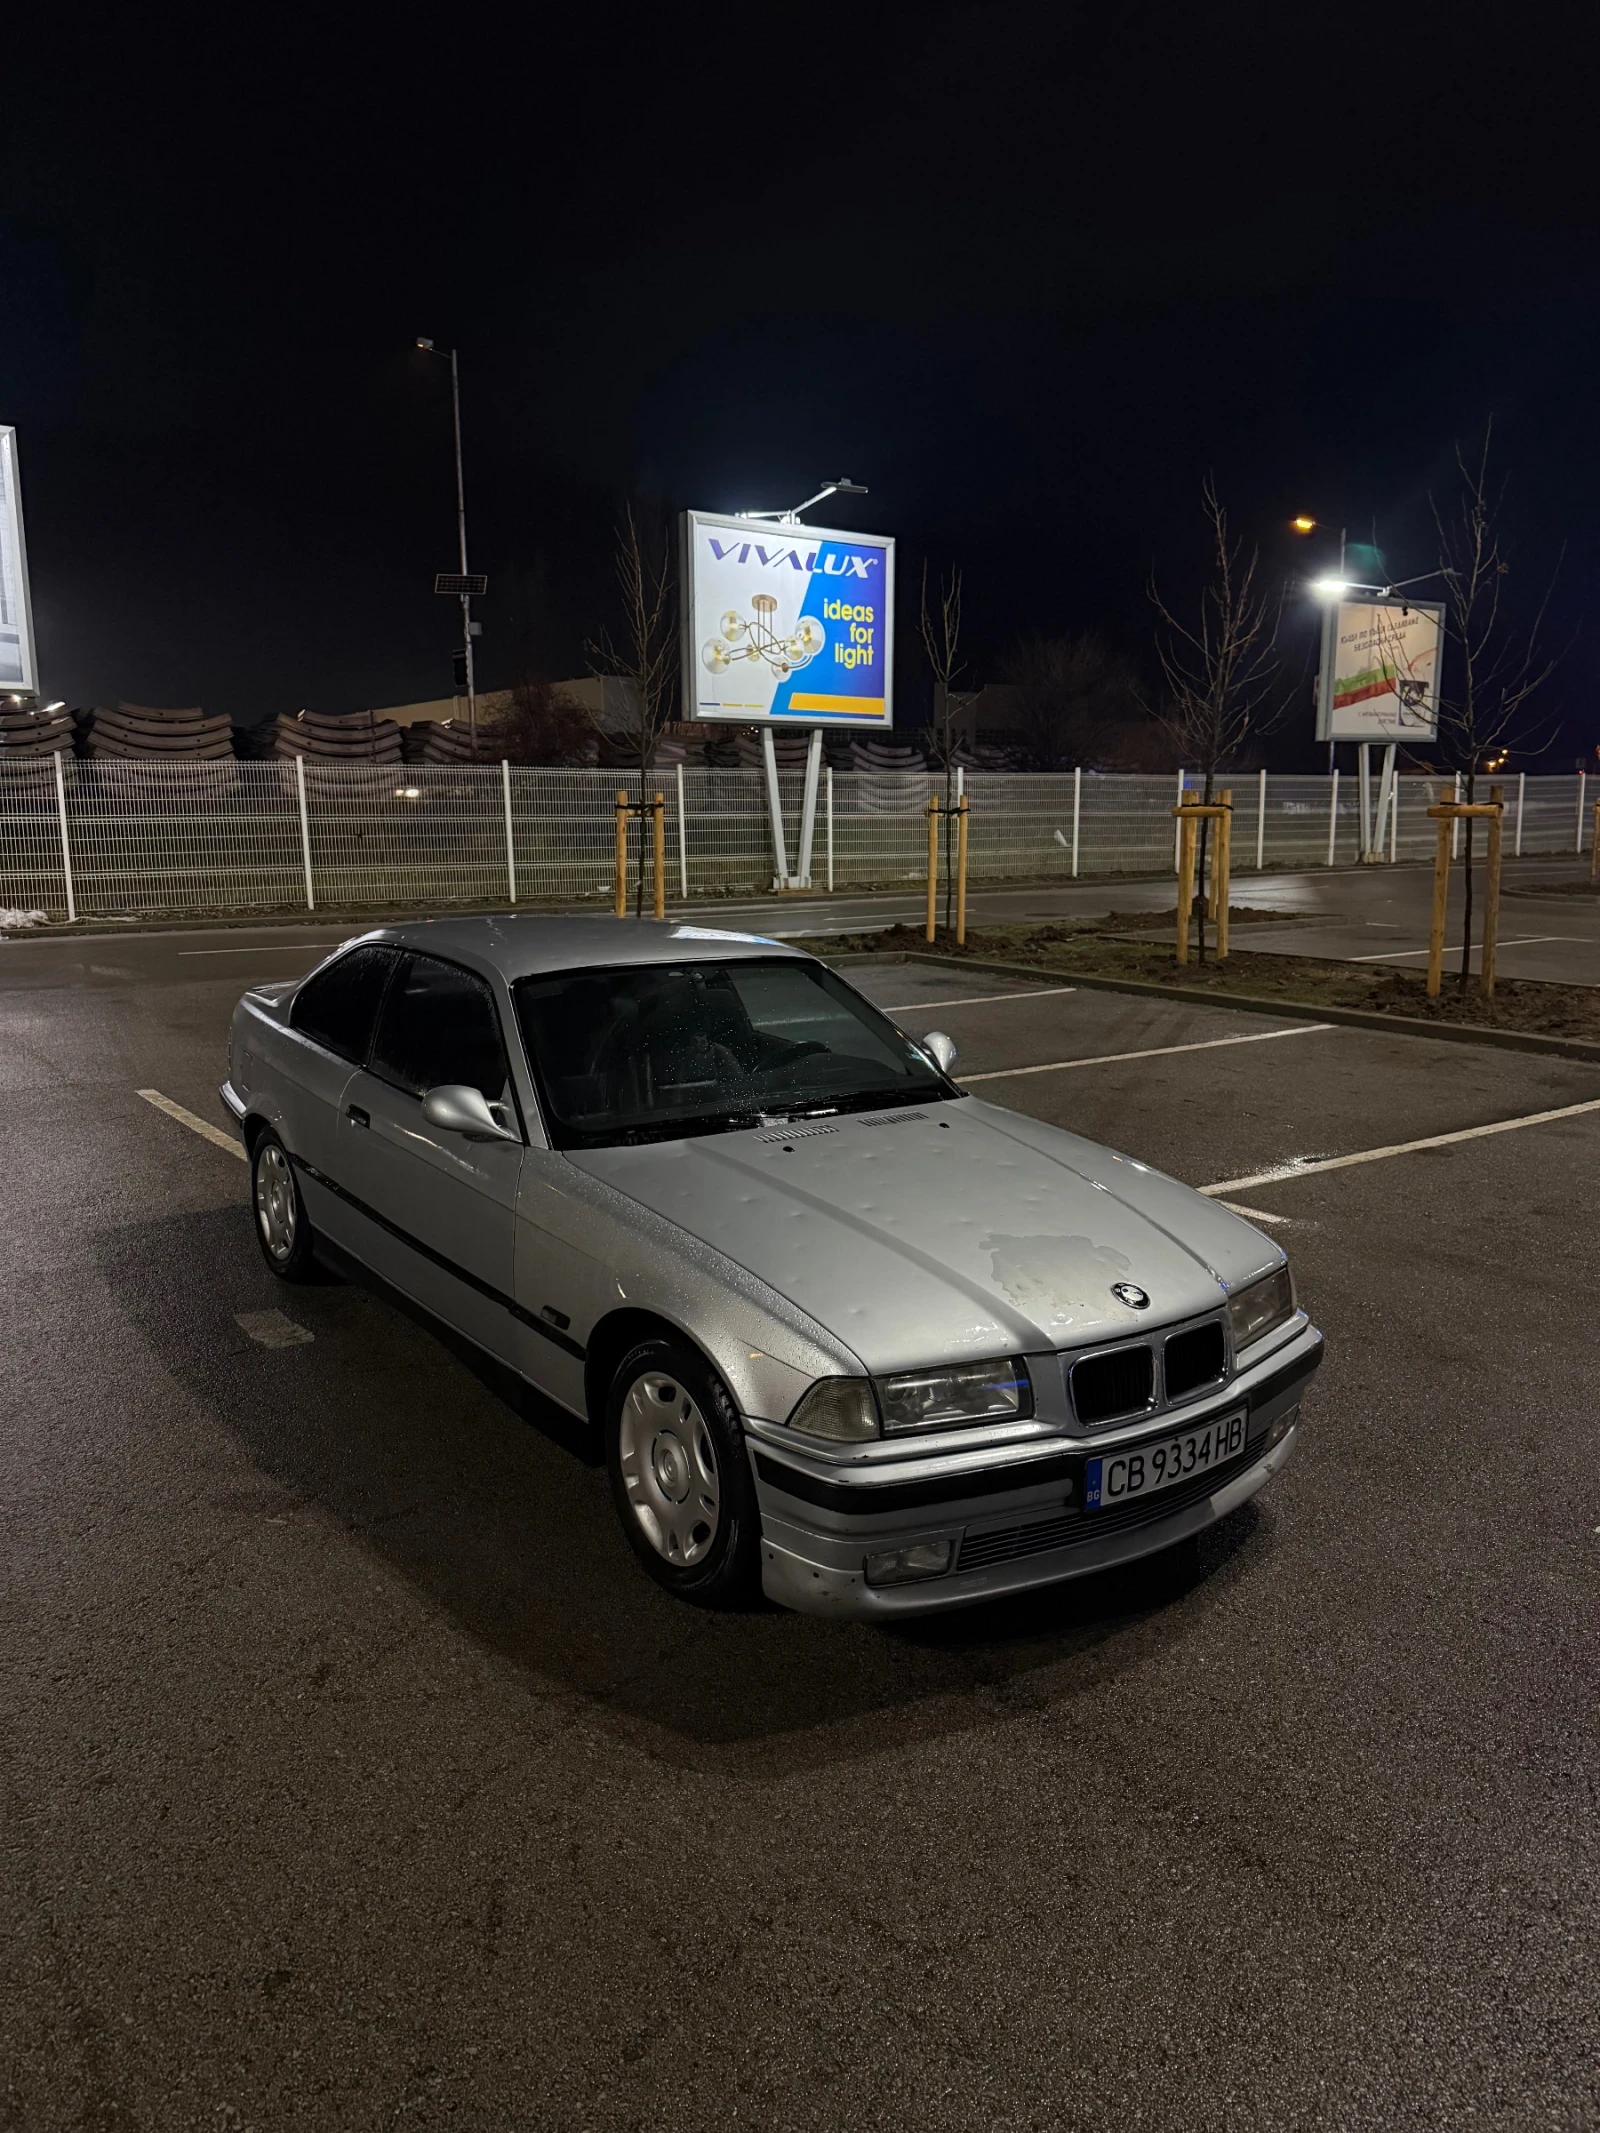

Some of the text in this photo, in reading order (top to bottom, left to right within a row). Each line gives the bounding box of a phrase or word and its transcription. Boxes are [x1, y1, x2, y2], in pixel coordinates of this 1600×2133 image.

[708, 538, 874, 578] VIVALUX
[823, 598, 874, 622] ideas
[849, 623, 874, 643] for
[834, 643, 874, 669] light
[1107, 1417, 1242, 1497] CB 9334 HB
[1086, 1490, 1100, 1503] BG
